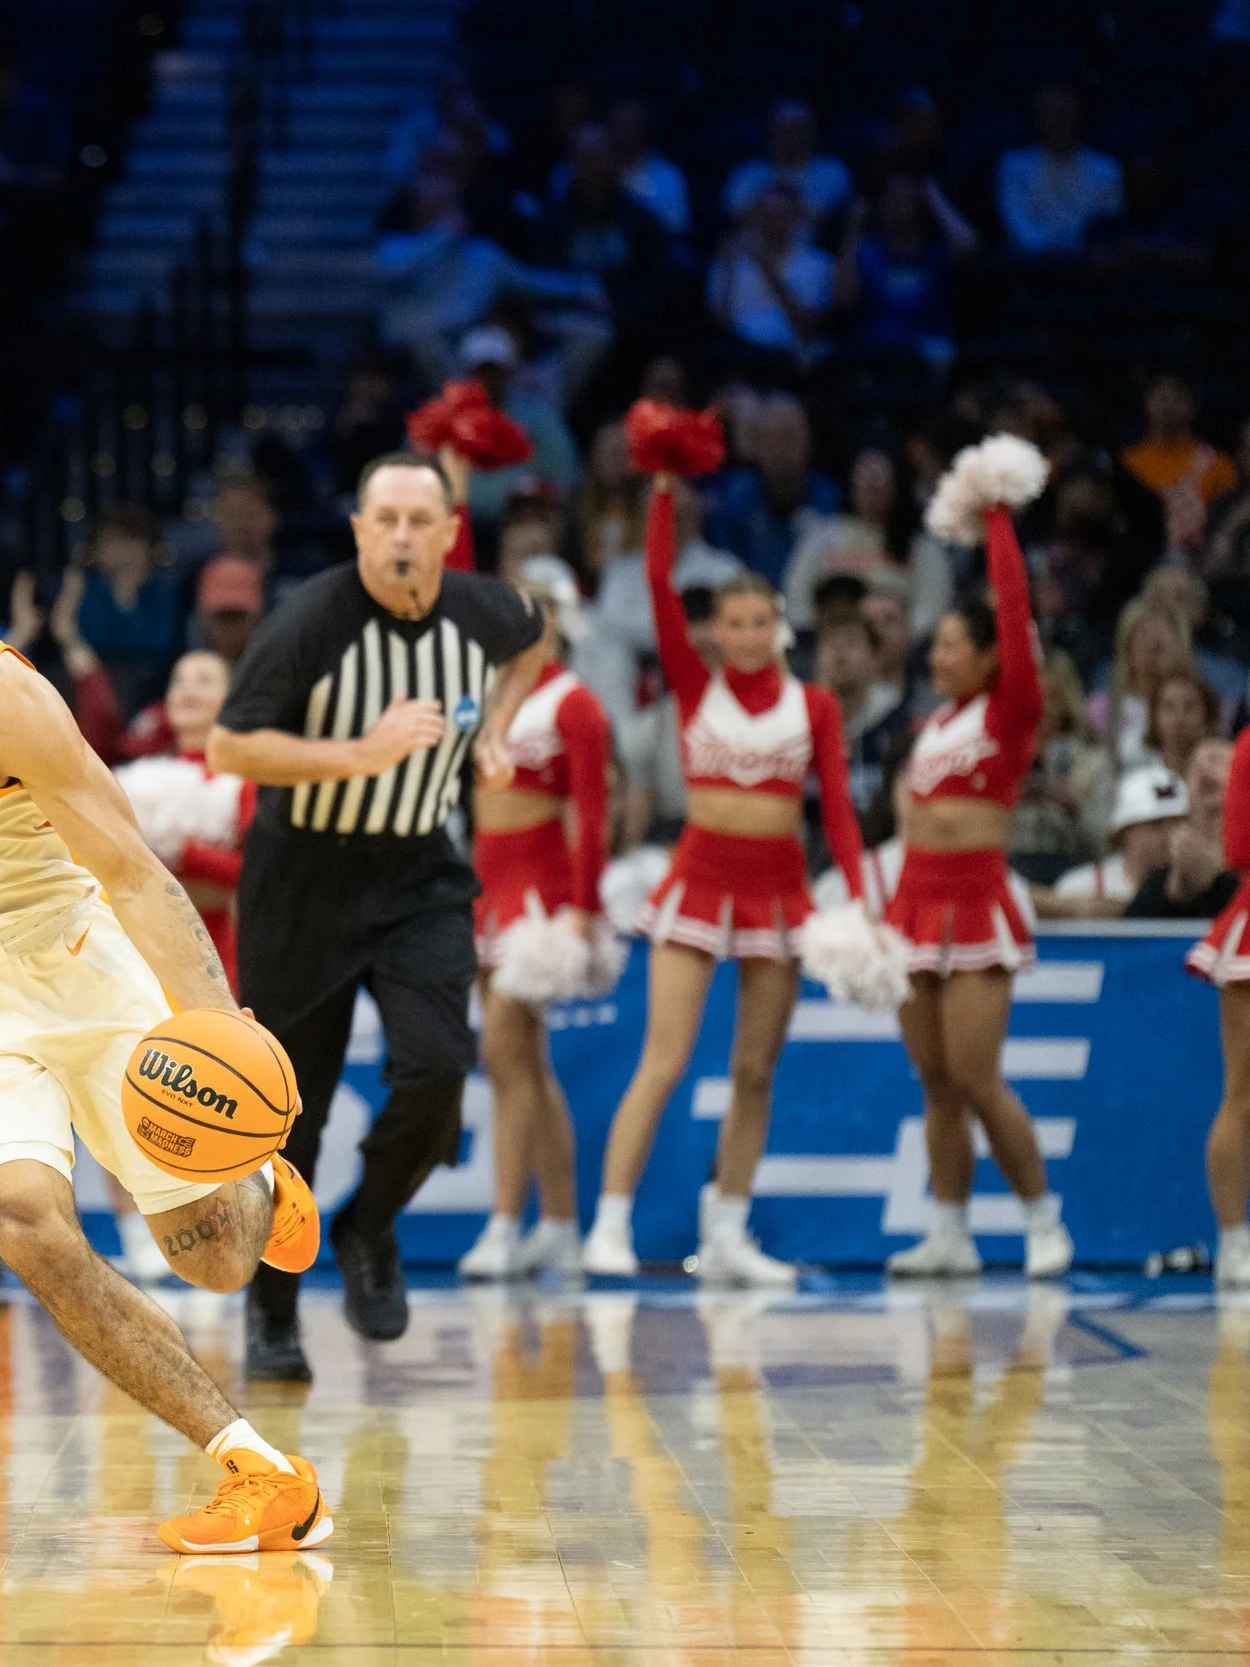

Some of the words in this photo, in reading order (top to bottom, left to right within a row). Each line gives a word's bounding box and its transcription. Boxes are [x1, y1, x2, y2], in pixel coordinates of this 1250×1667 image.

[139, 1048, 238, 1120] Wilson
[161, 1089, 176, 1099] EVO
[177, 1097, 194, 1108] NXT
[148, 1122, 179, 1144] MARCH
[149, 1133, 191, 1156] MADNESS
